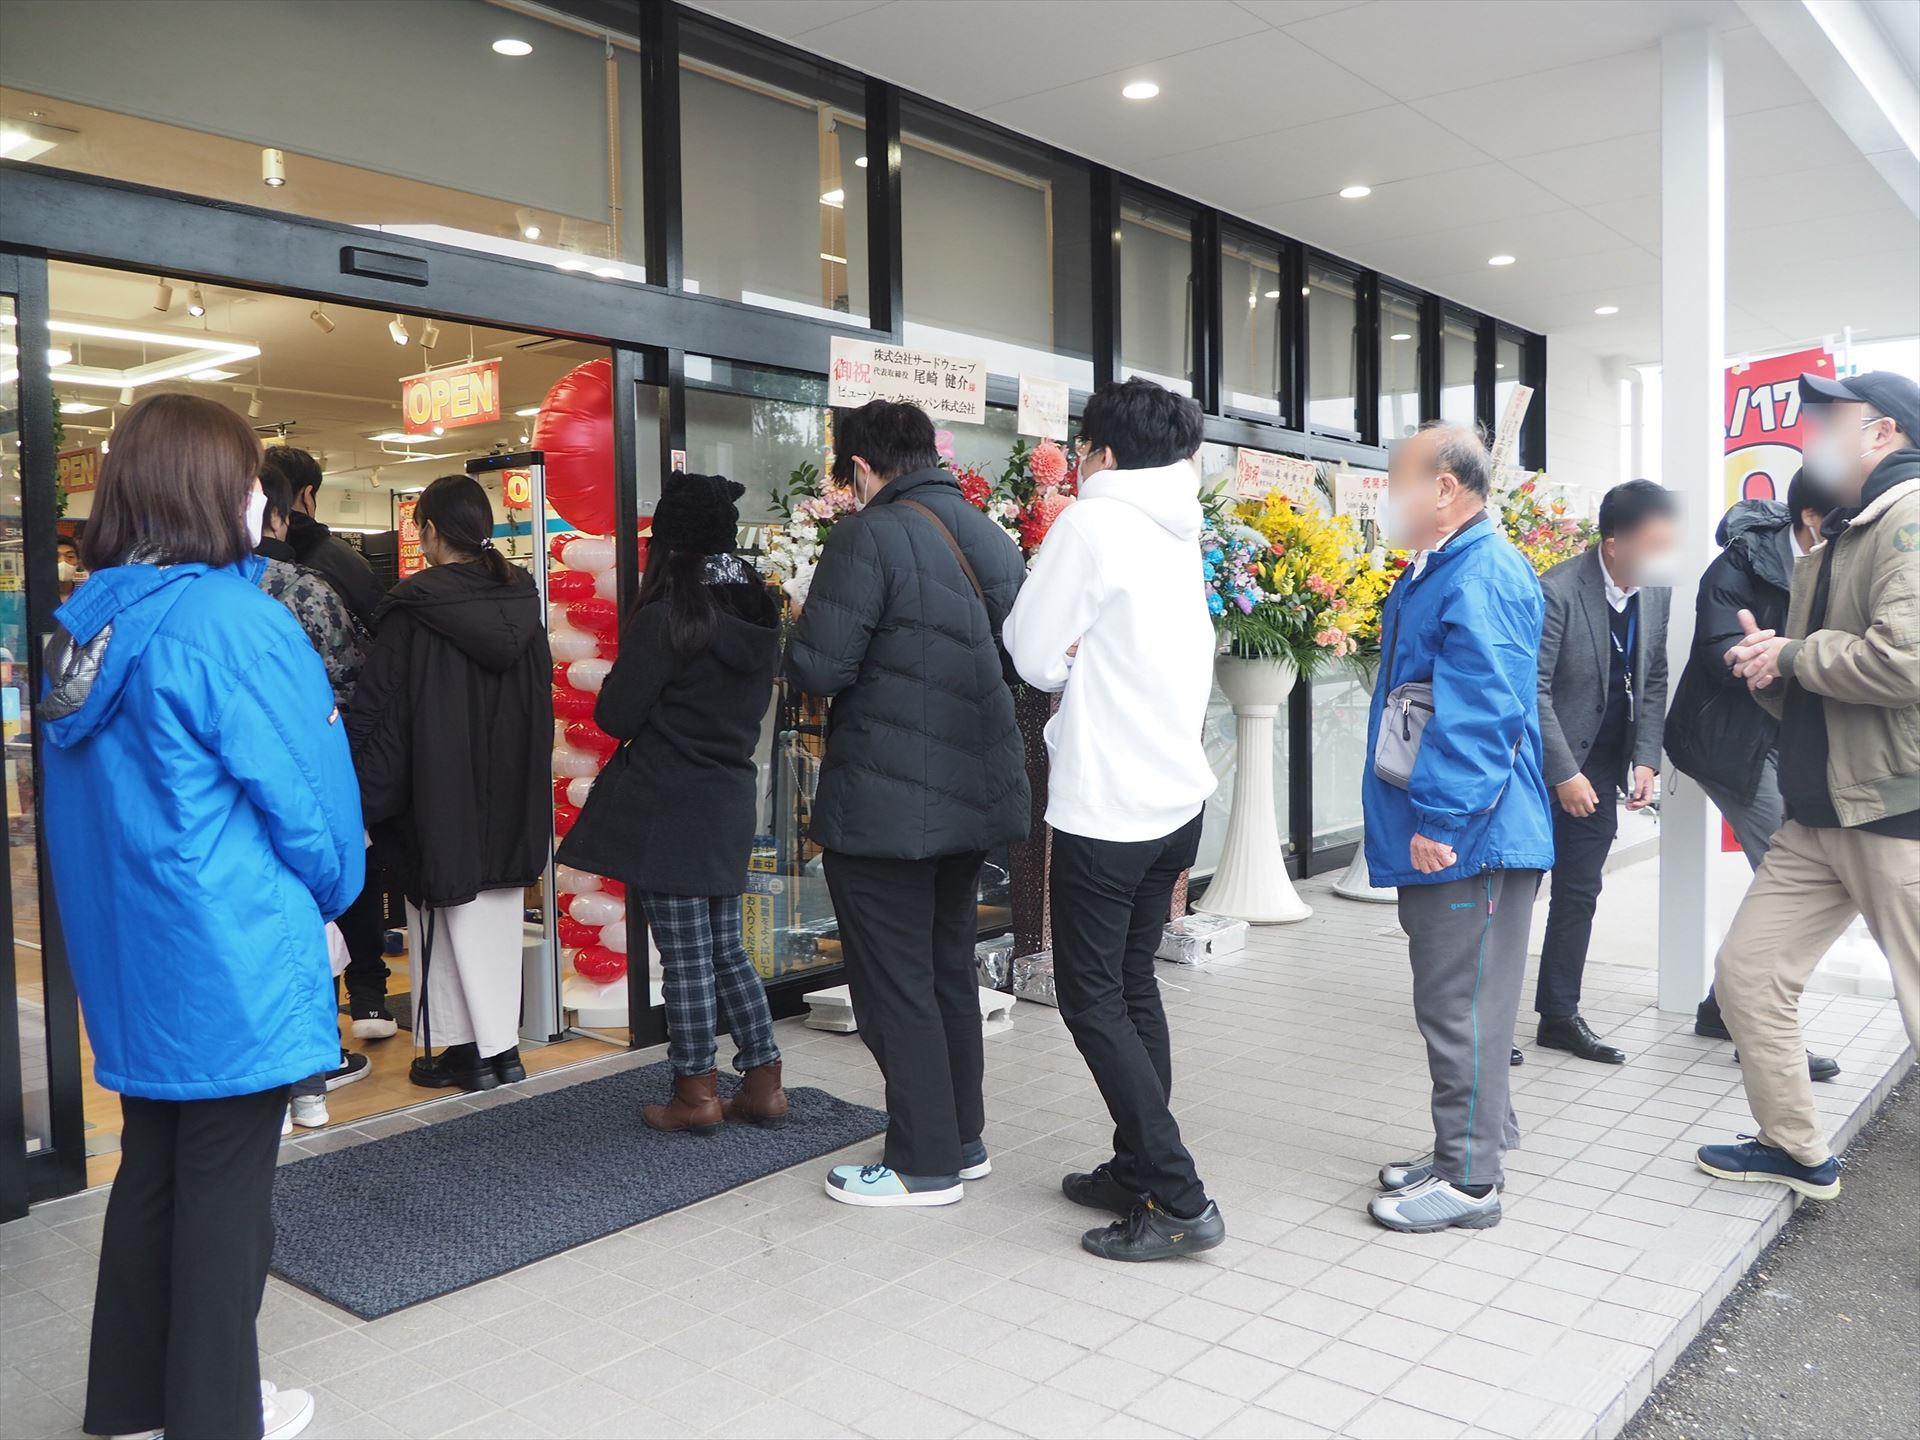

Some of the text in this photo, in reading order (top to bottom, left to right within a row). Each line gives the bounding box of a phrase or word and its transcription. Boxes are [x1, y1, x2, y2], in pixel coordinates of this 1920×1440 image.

[833, 358, 871, 384] 御祝
[874, 348, 976, 373] 株式会社サードウェーブ
[408, 369, 493, 425] OPEN
[1724, 379, 1802, 439] /17
[507, 475, 531, 503] O
